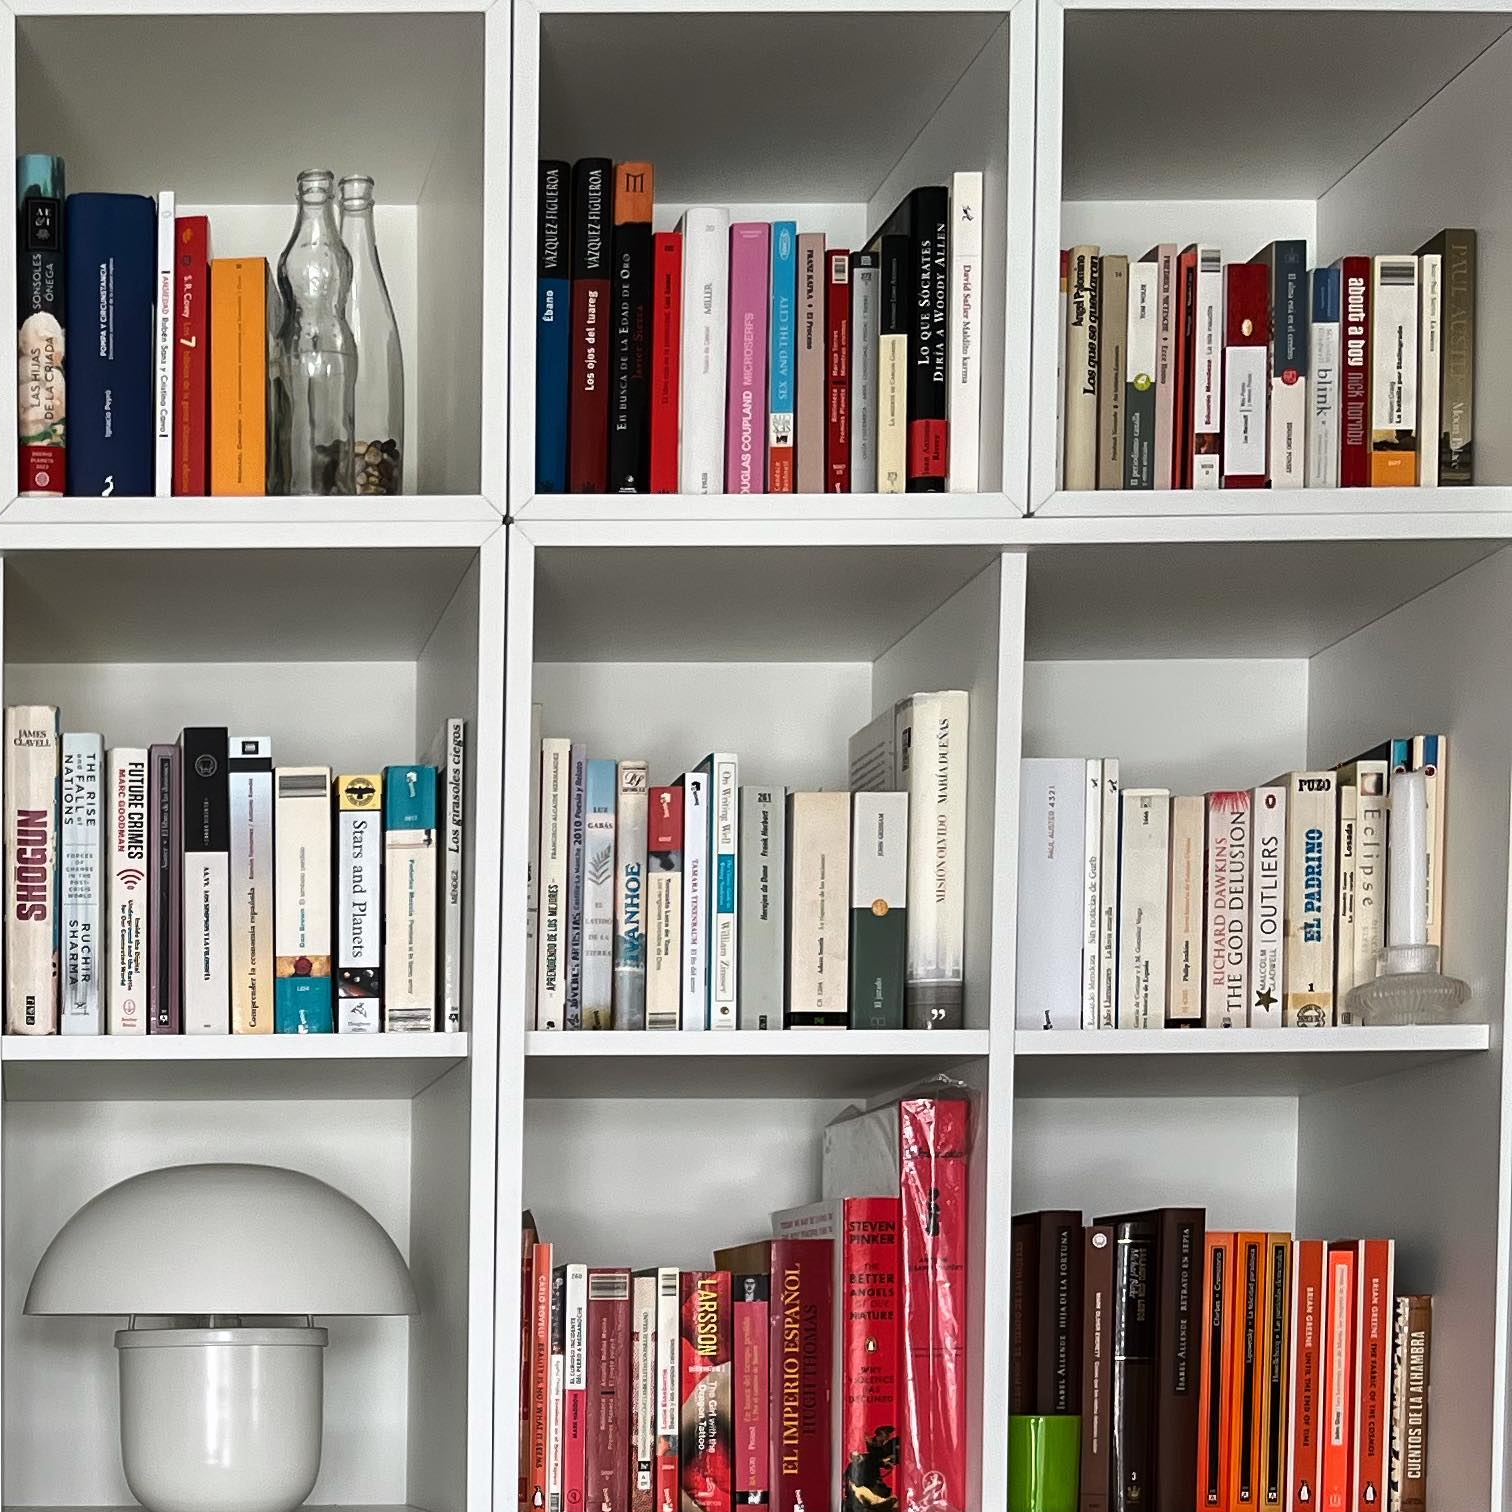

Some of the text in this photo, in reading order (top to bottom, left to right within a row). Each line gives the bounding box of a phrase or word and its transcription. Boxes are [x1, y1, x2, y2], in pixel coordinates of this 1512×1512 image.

[31, 253, 42, 310] SONSOLES
[541, 290, 555, 322] Ébano
[1347, 277, 1366, 367] about a boy
[30, 347, 41, 408] LAS HIJAS
[44, 336, 55, 421] DE LA CRIADA
[584, 290, 600, 391] Los ojos del tuareg
[1315, 368, 1333, 416] blink
[1347, 372, 1365, 397] nick
[935, 718, 949, 764] DUEÑAS
[127, 762, 145, 860] FUTURE CRIMES
[935, 765, 949, 804] MARÍA
[350, 820, 368, 958] Stars and Planets
[624, 862, 642, 963] IVANHOE
[933, 859, 947, 903] MISIÓN
[1212, 836, 1227, 986] RICHARD DAWKINS
[1227, 809, 1245, 1013] THE GOD DELUSION
[1259, 835, 1278, 935] OUTLIERS
[848, 1233, 896, 1245] PINKER
[698, 1279, 718, 1356] LARSSON
[780, 1263, 801, 1475] EL IMPERIO ESPAÑOL
[1056, 1335, 1068, 1410] ISABEL ALLENDE
[1406, 1330, 1426, 1479] CUENTOS DE LA ALHAMBRA
